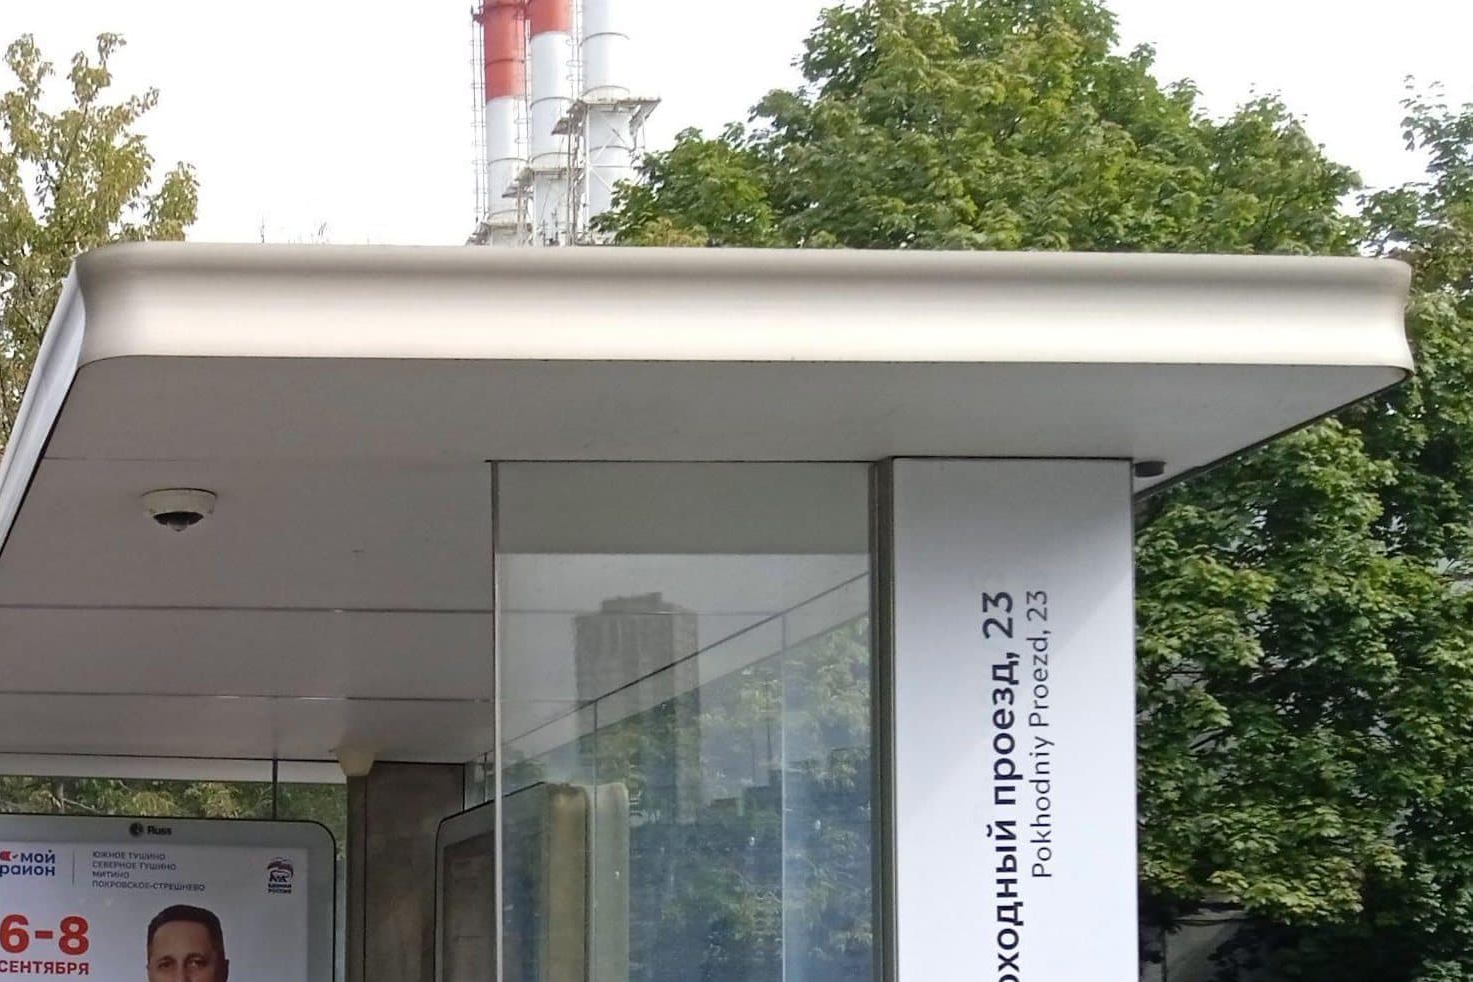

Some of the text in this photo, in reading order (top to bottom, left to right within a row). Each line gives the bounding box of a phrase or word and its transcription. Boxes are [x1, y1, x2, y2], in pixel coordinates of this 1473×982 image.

[982, 591, 1014, 640] 23
[991, 652, 1023, 805] проезд,
[1026, 589, 1056, 878] Pokhodniy Proezd, 23
